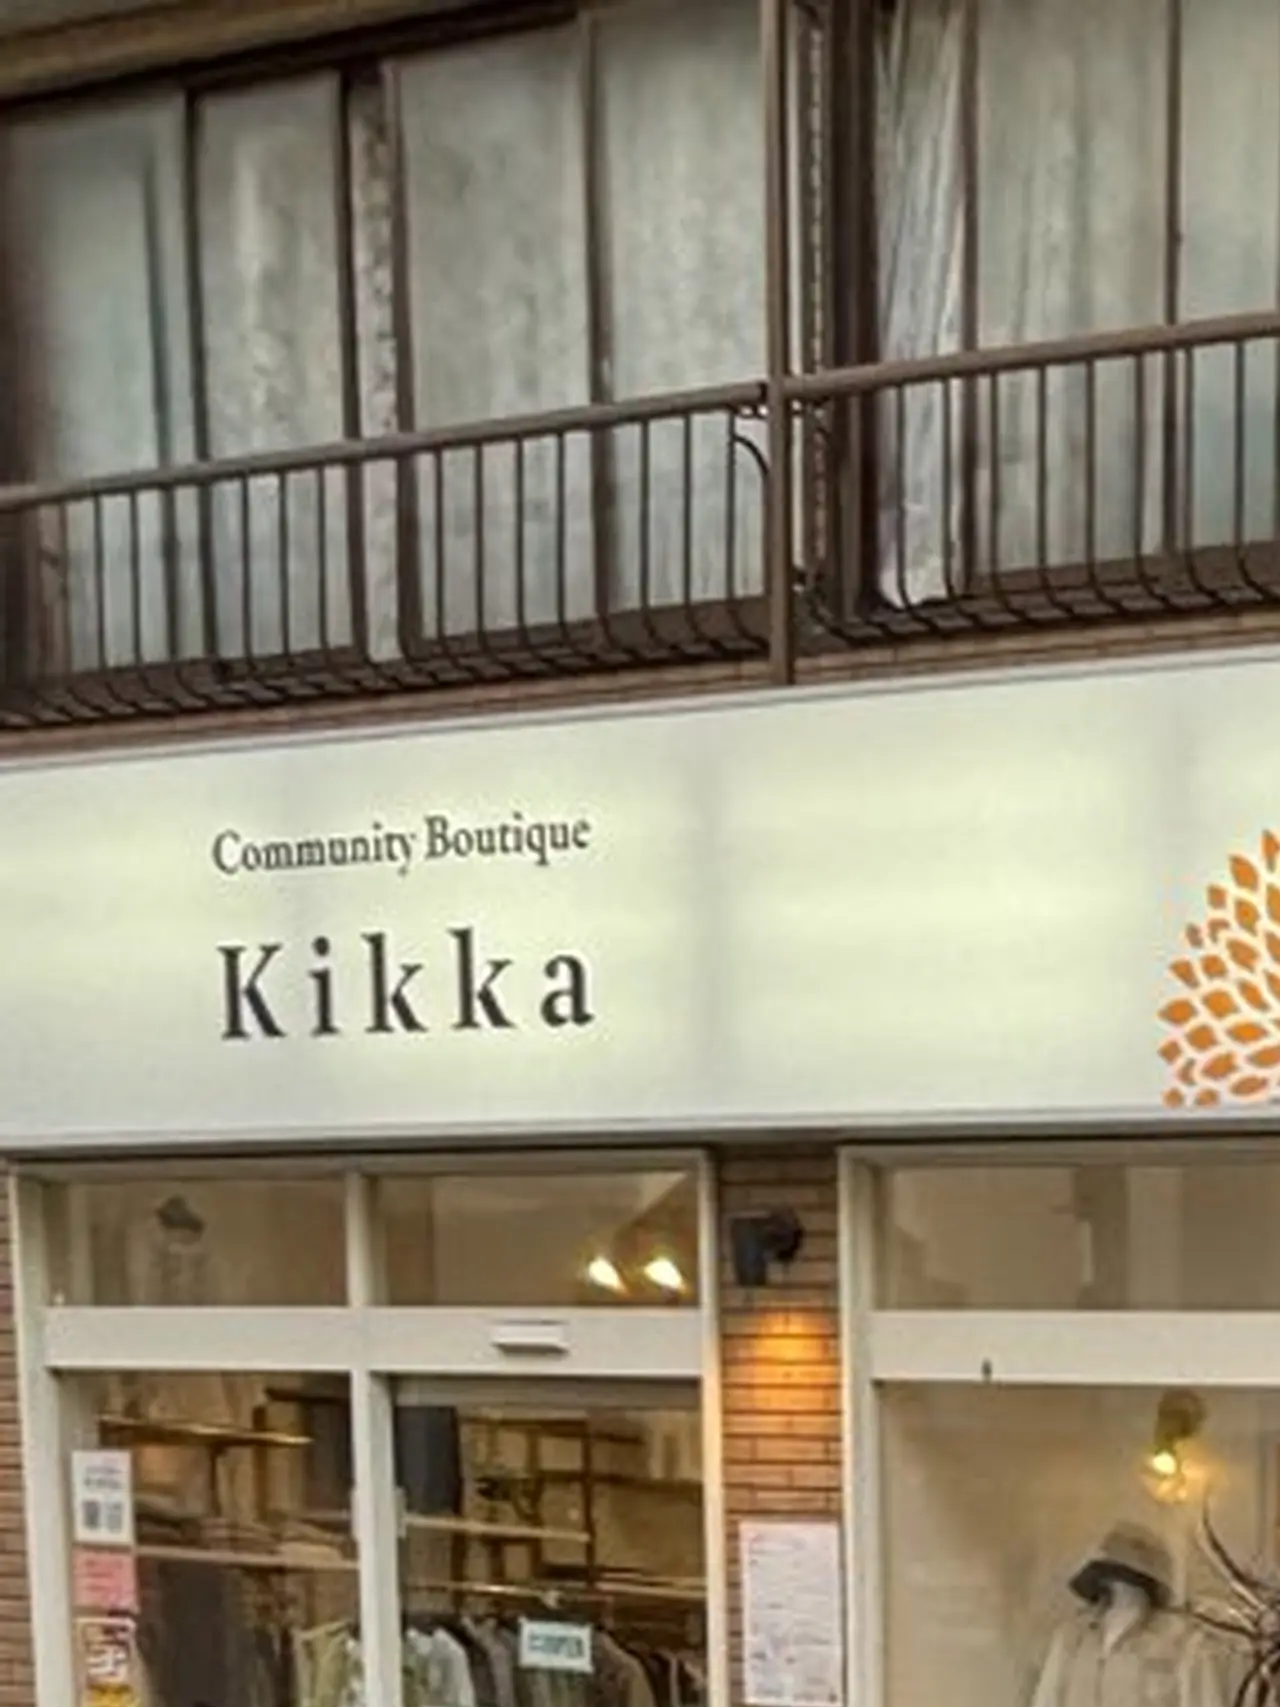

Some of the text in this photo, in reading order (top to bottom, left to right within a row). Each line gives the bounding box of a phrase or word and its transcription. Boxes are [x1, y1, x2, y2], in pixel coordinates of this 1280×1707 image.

[211, 810, 593, 877] Community Boutique
[217, 926, 597, 1042] Kikka
